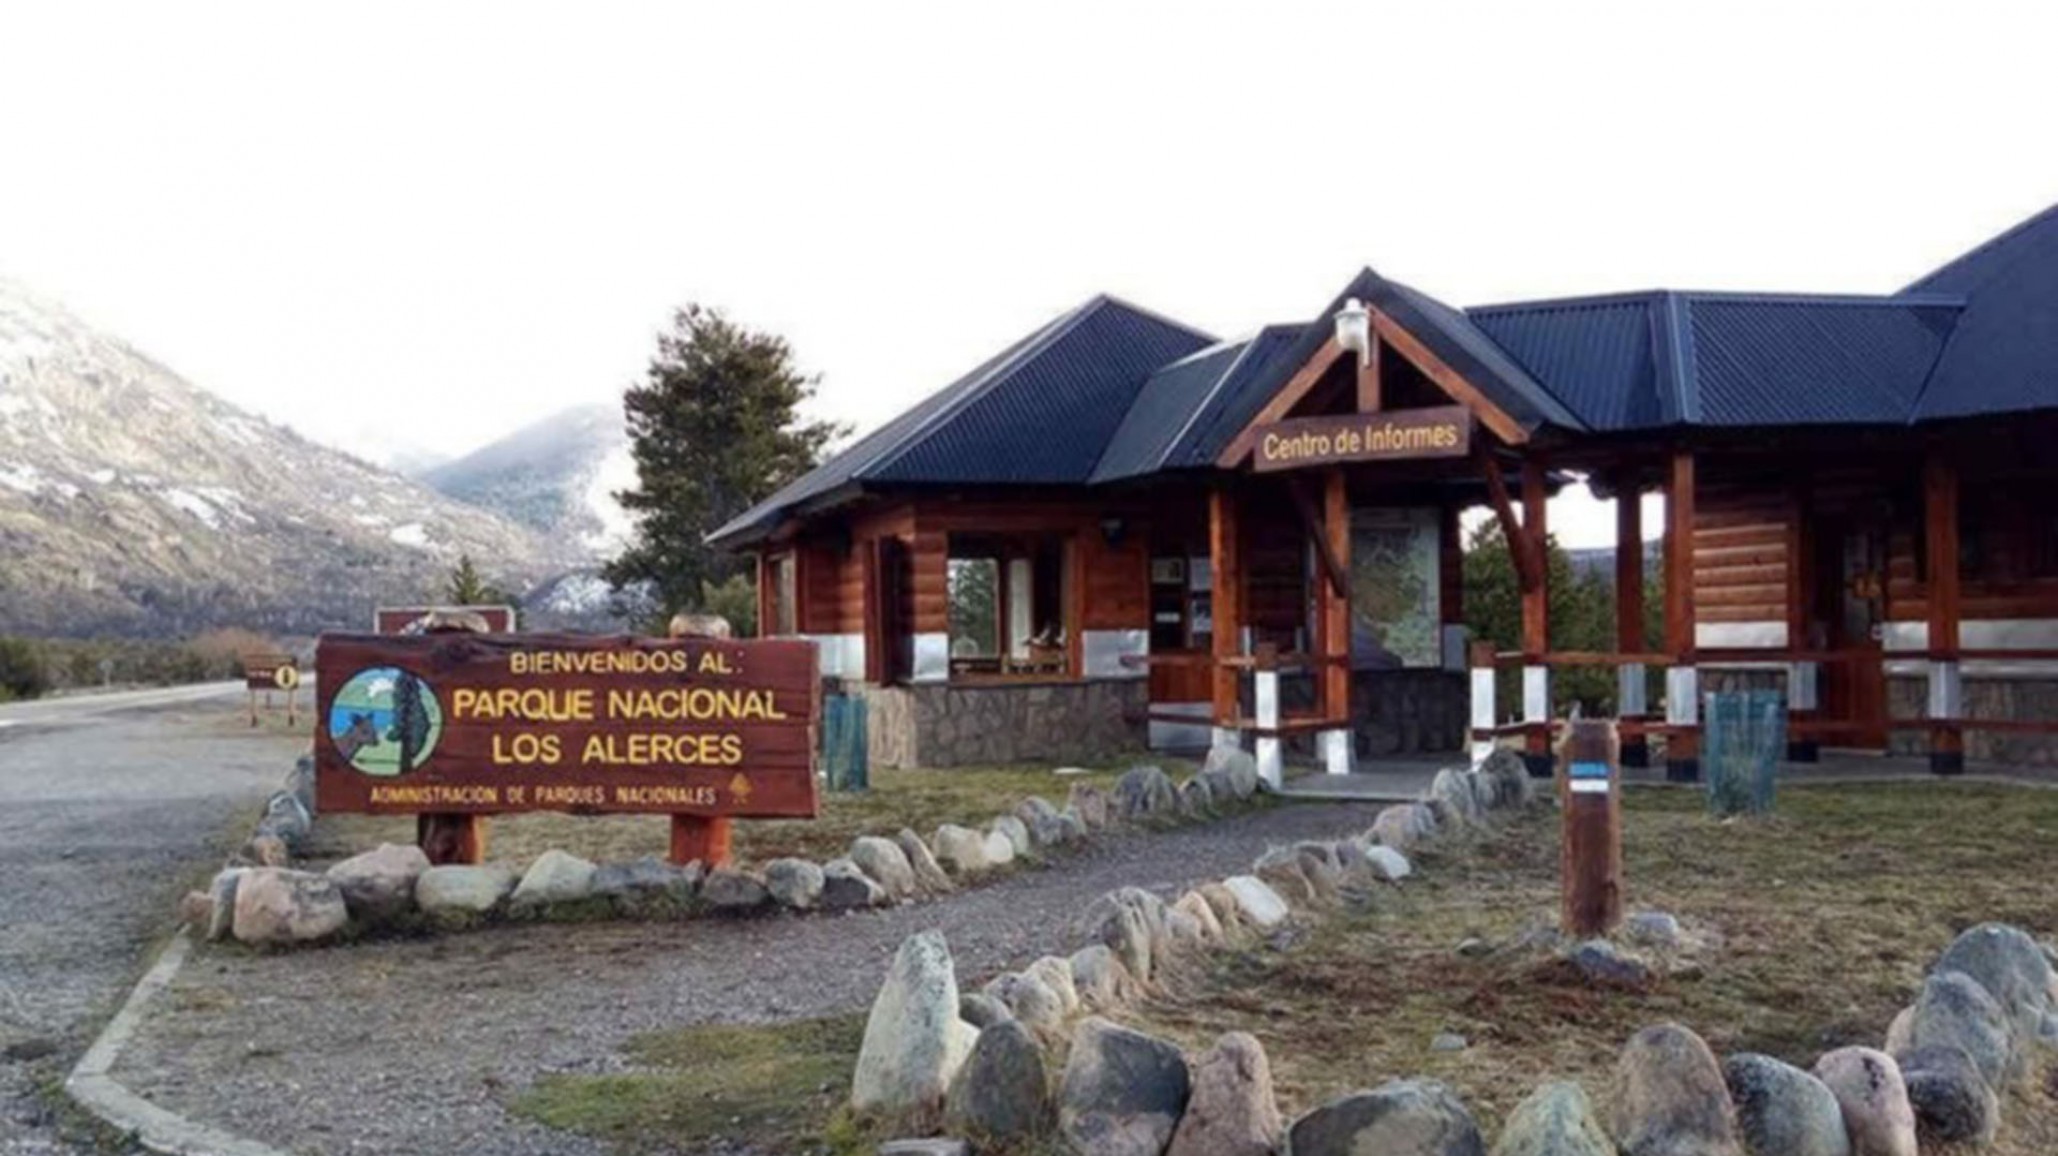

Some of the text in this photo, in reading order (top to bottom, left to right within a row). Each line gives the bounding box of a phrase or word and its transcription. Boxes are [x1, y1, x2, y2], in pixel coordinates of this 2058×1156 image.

[1262, 422, 1458, 460] Centro de Informes
[510, 650, 687, 674] BIENVENIDOS
[453, 689, 786, 721] PARQUE NACIONAL
[492, 733, 742, 764] LOS ALERCES
[507, 787, 527, 804] DE
[536, 786, 605, 804] PARQUES
[616, 786, 716, 805] NACIONALES
